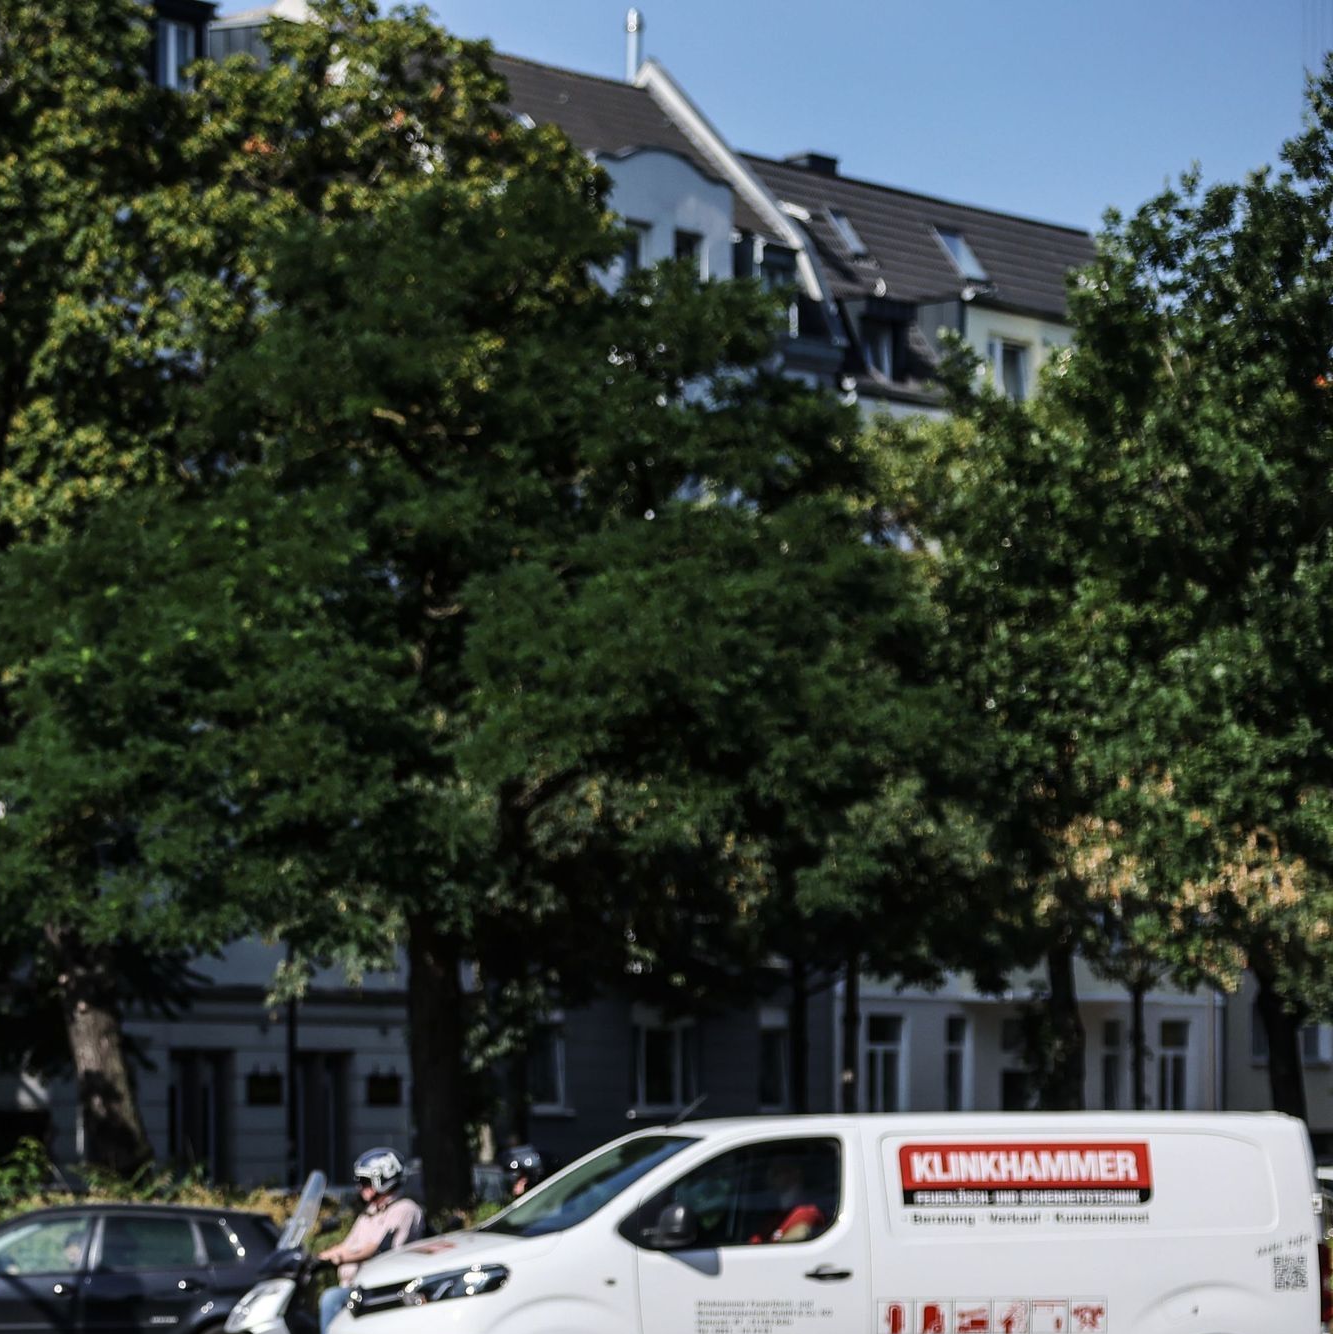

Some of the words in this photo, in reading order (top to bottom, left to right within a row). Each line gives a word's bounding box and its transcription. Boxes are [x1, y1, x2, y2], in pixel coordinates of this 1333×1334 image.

[909, 1150, 1139, 1183] KLINKHAMMER
[912, 1212, 976, 1225] Beratung
[989, 1211, 1041, 1224] Verkauf
